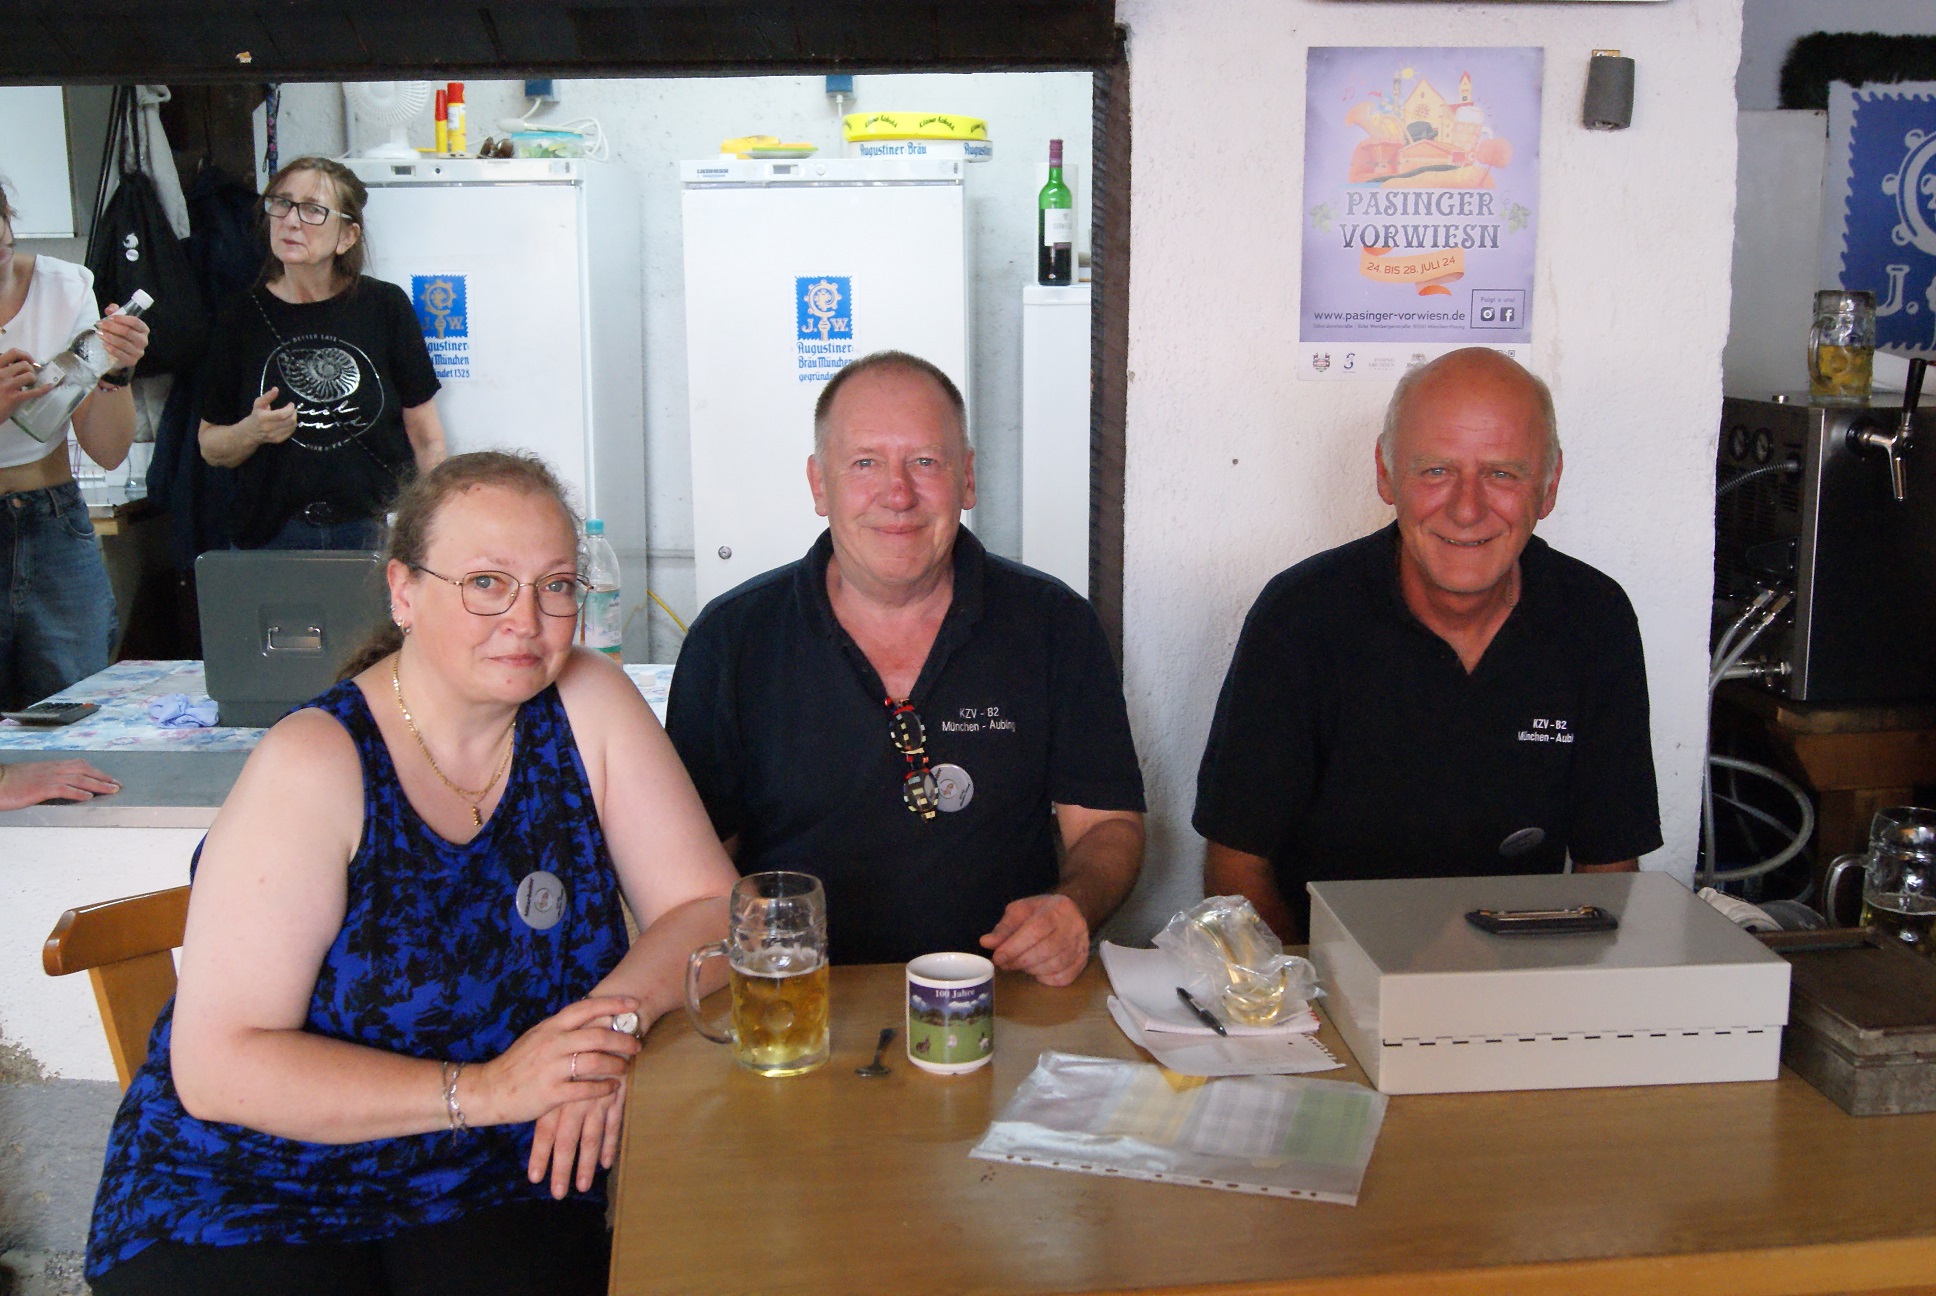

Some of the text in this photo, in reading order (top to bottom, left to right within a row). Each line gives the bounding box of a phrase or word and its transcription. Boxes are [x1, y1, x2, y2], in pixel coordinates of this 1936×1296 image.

[907, 142, 927, 155] Bräu
[1346, 191, 1495, 217] PASINGER
[1339, 223, 1501, 249] VORWIESN
[1366, 255, 1456, 275] 24. BIS 28. JULI 24
[1314, 308, 1466, 323] www.pasinger-vorwiesn.de
[801, 318, 849, 333] J. W.
[798, 356, 817, 369] Bräu
[798, 371, 835, 383] gegründe
[959, 707, 977, 719] KZV
[987, 706, 999, 717] B2
[941, 721, 980, 732] München
[1533, 718, 1550, 730] KZV
[1555, 720, 1567, 730] B2
[934, 989, 975, 999] 100 Jahre
